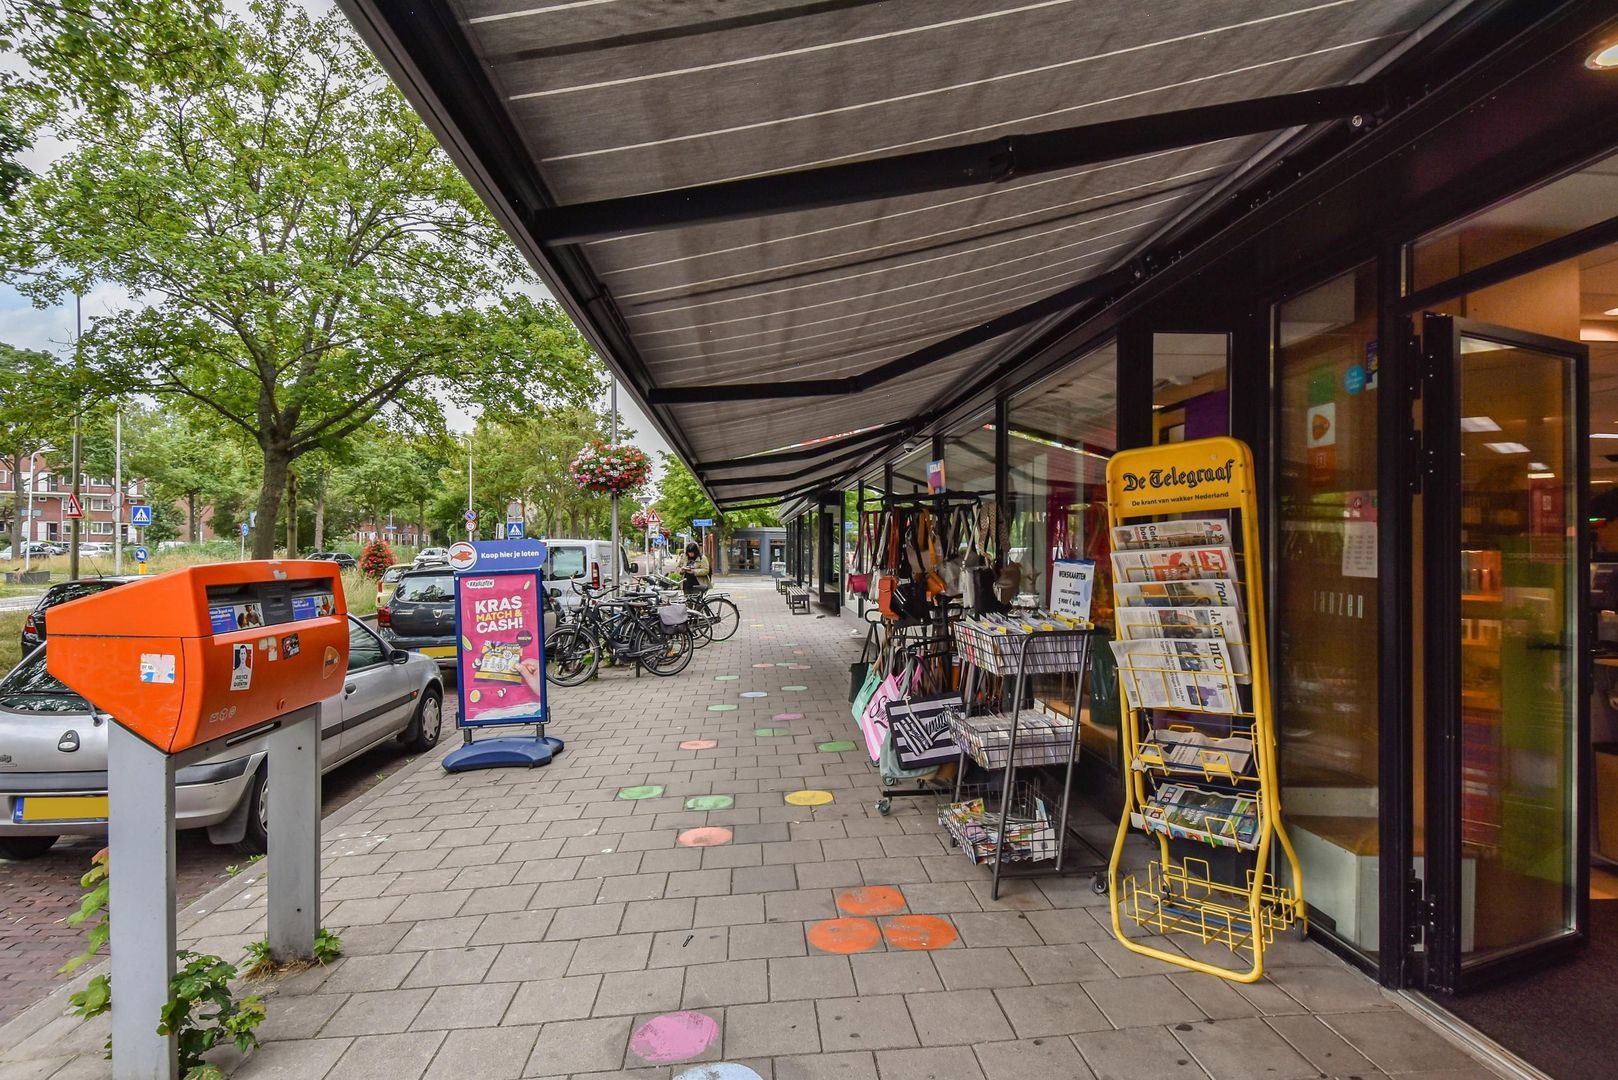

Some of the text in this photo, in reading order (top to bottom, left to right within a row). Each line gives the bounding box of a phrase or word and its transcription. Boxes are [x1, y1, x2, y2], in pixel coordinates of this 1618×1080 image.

[1123, 458, 1235, 491] De Telegraaf
[1141, 498, 1157, 506] krant
[1195, 491, 1229, 501] Nederland
[481, 551, 498, 560] Koop
[513, 550, 520, 559] je
[475, 596, 522, 613] KRAS
[476, 608, 522, 622] MATCH &
[476, 617, 523, 633] CASH!
